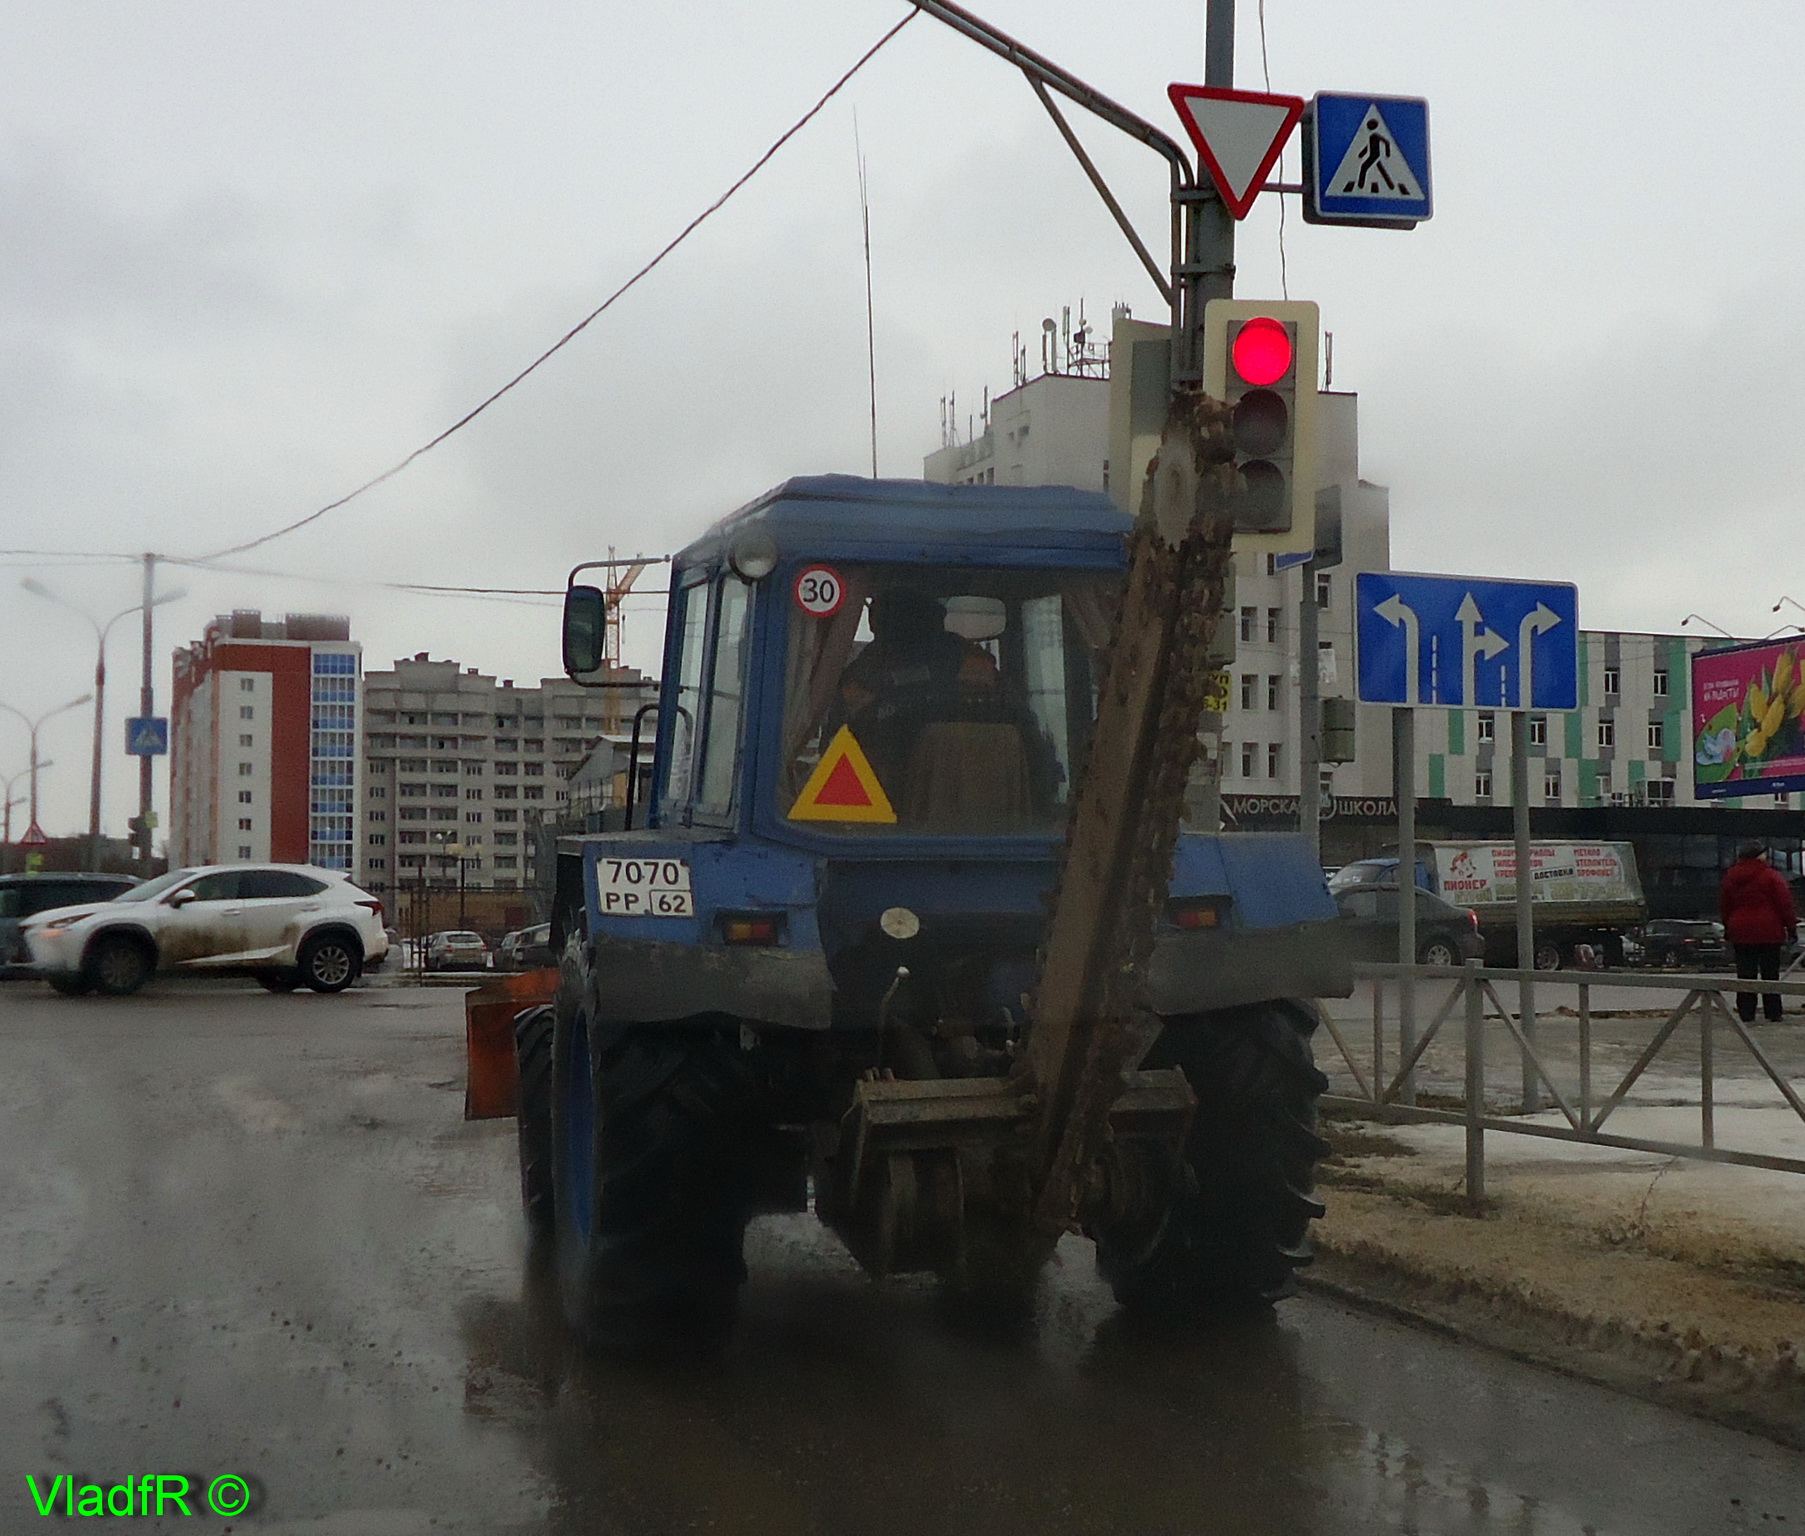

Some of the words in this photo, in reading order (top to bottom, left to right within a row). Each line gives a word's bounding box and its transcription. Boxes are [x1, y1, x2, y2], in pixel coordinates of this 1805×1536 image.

[803, 578, 835, 604] 30
[1232, 799, 1301, 815] МОРСКА
[1339, 801, 1398, 816] ШКОЛА
[606, 861, 679, 885] 7070
[1534, 868, 1574, 880] ДОСТАВКА
[1443, 880, 1487, 891] ПИОНЕР
[606, 892, 640, 911] РР
[658, 894, 687, 913] 62
